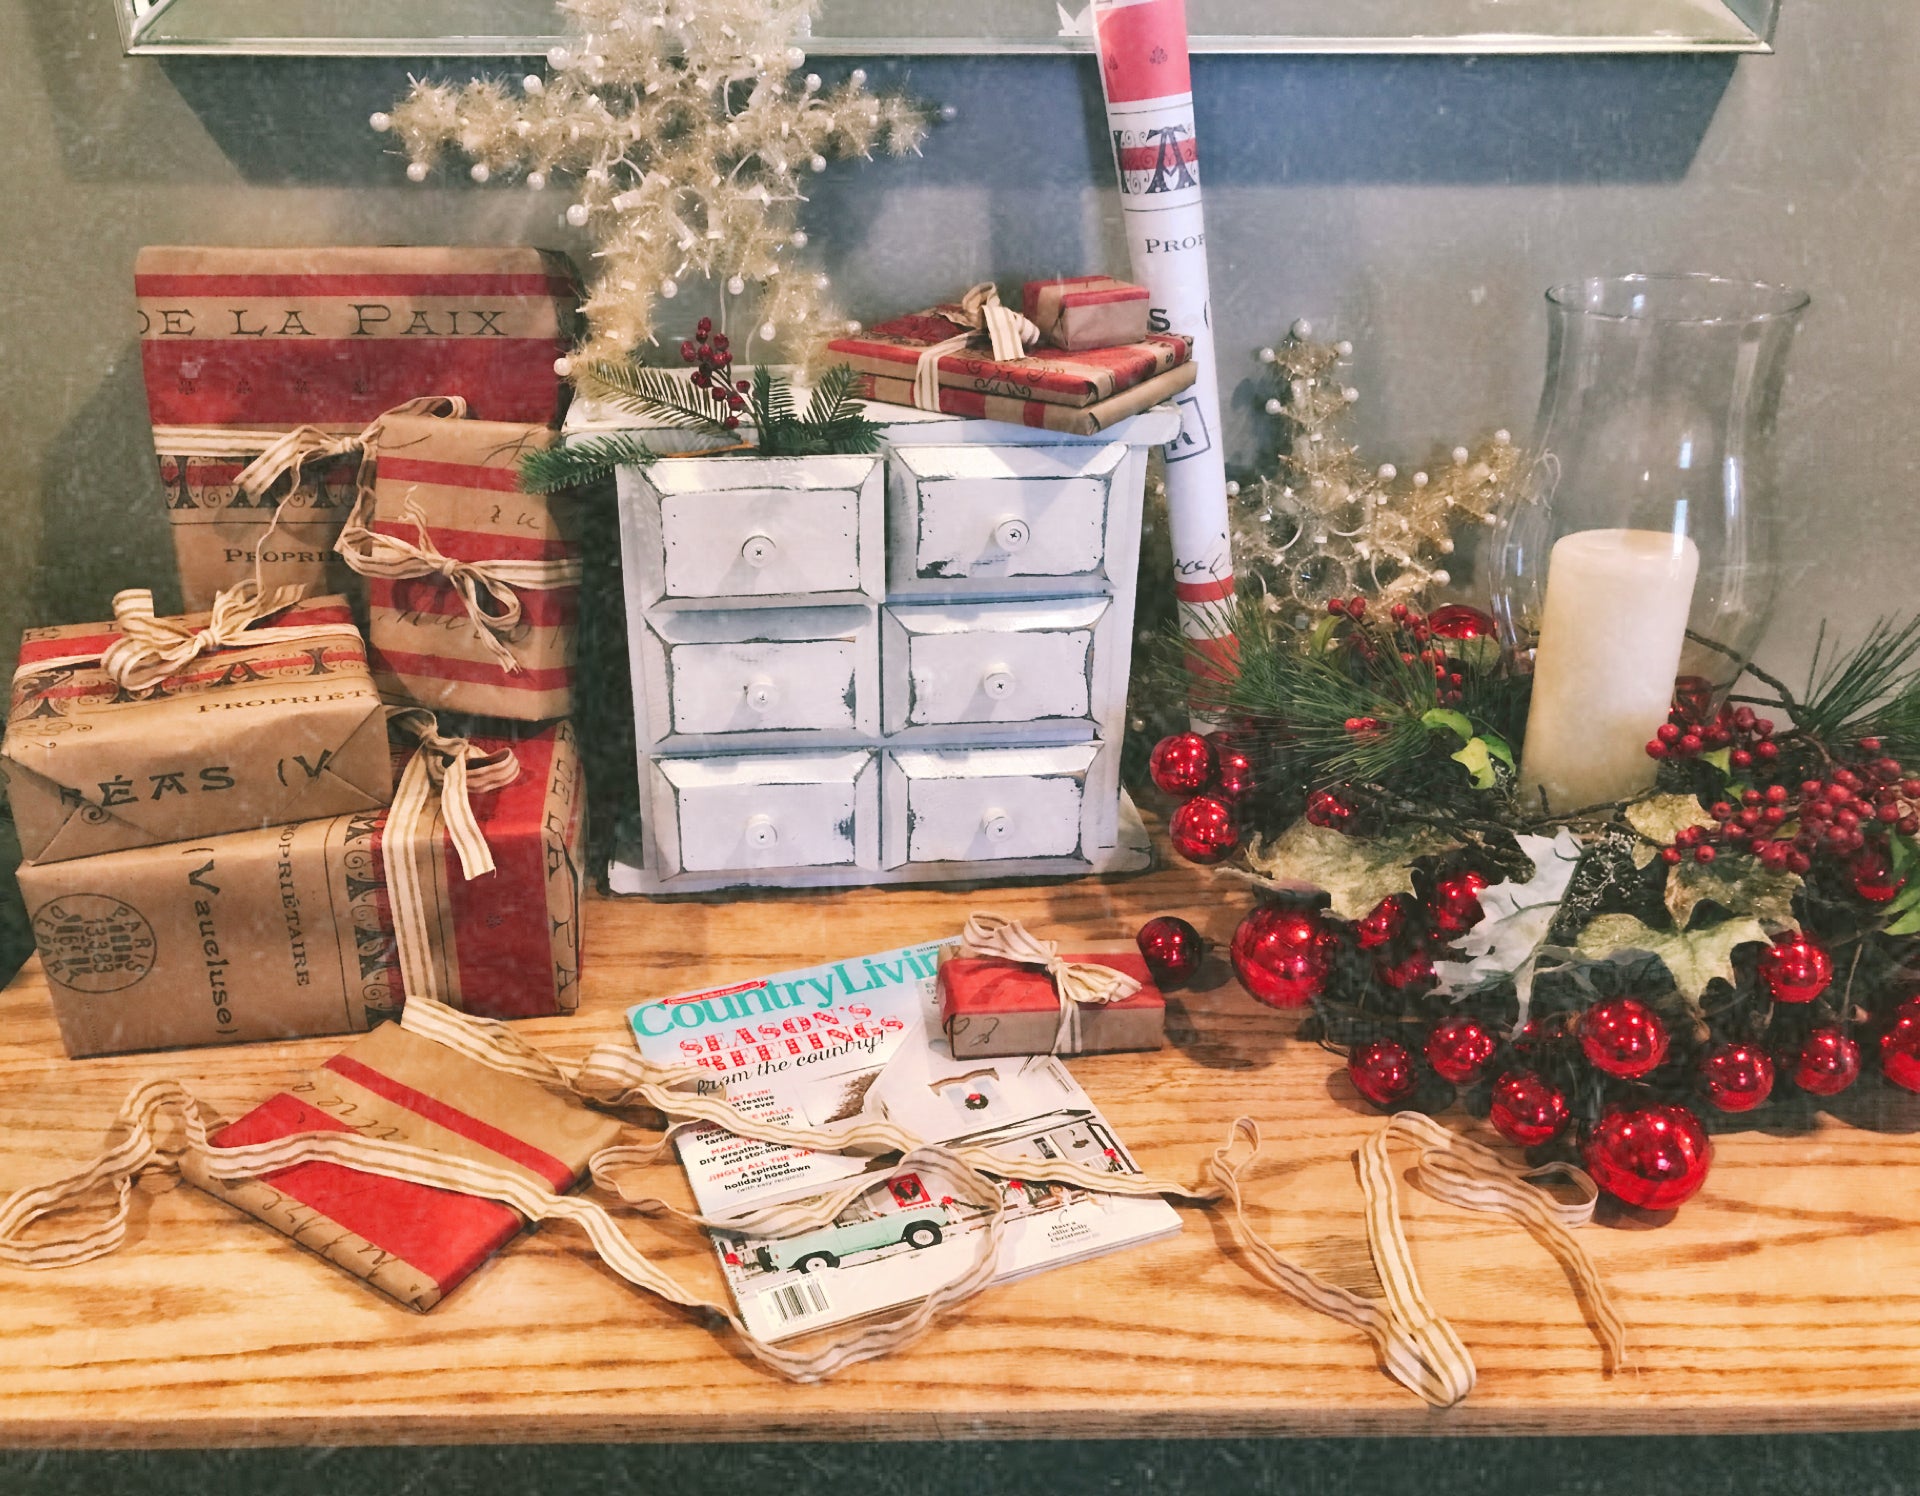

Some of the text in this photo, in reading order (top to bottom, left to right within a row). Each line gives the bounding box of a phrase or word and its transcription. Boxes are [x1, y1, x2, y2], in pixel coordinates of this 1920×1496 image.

[228, 308, 317, 336] LA
[347, 303, 510, 336] PAIX
[198, 689, 374, 713] PROPRIÉT
[674, 1014, 904, 1071] REETINGS
[679, 1001, 873, 1059] SEASON'S
[696, 1029, 885, 1097] from the country!
[699, 1156, 717, 1166] DIY
[723, 1156, 743, 1166] and
[747, 1161, 767, 1170] ALL
[771, 1154, 791, 1165] THE
[724, 1164, 811, 1191] holiday hoedown
